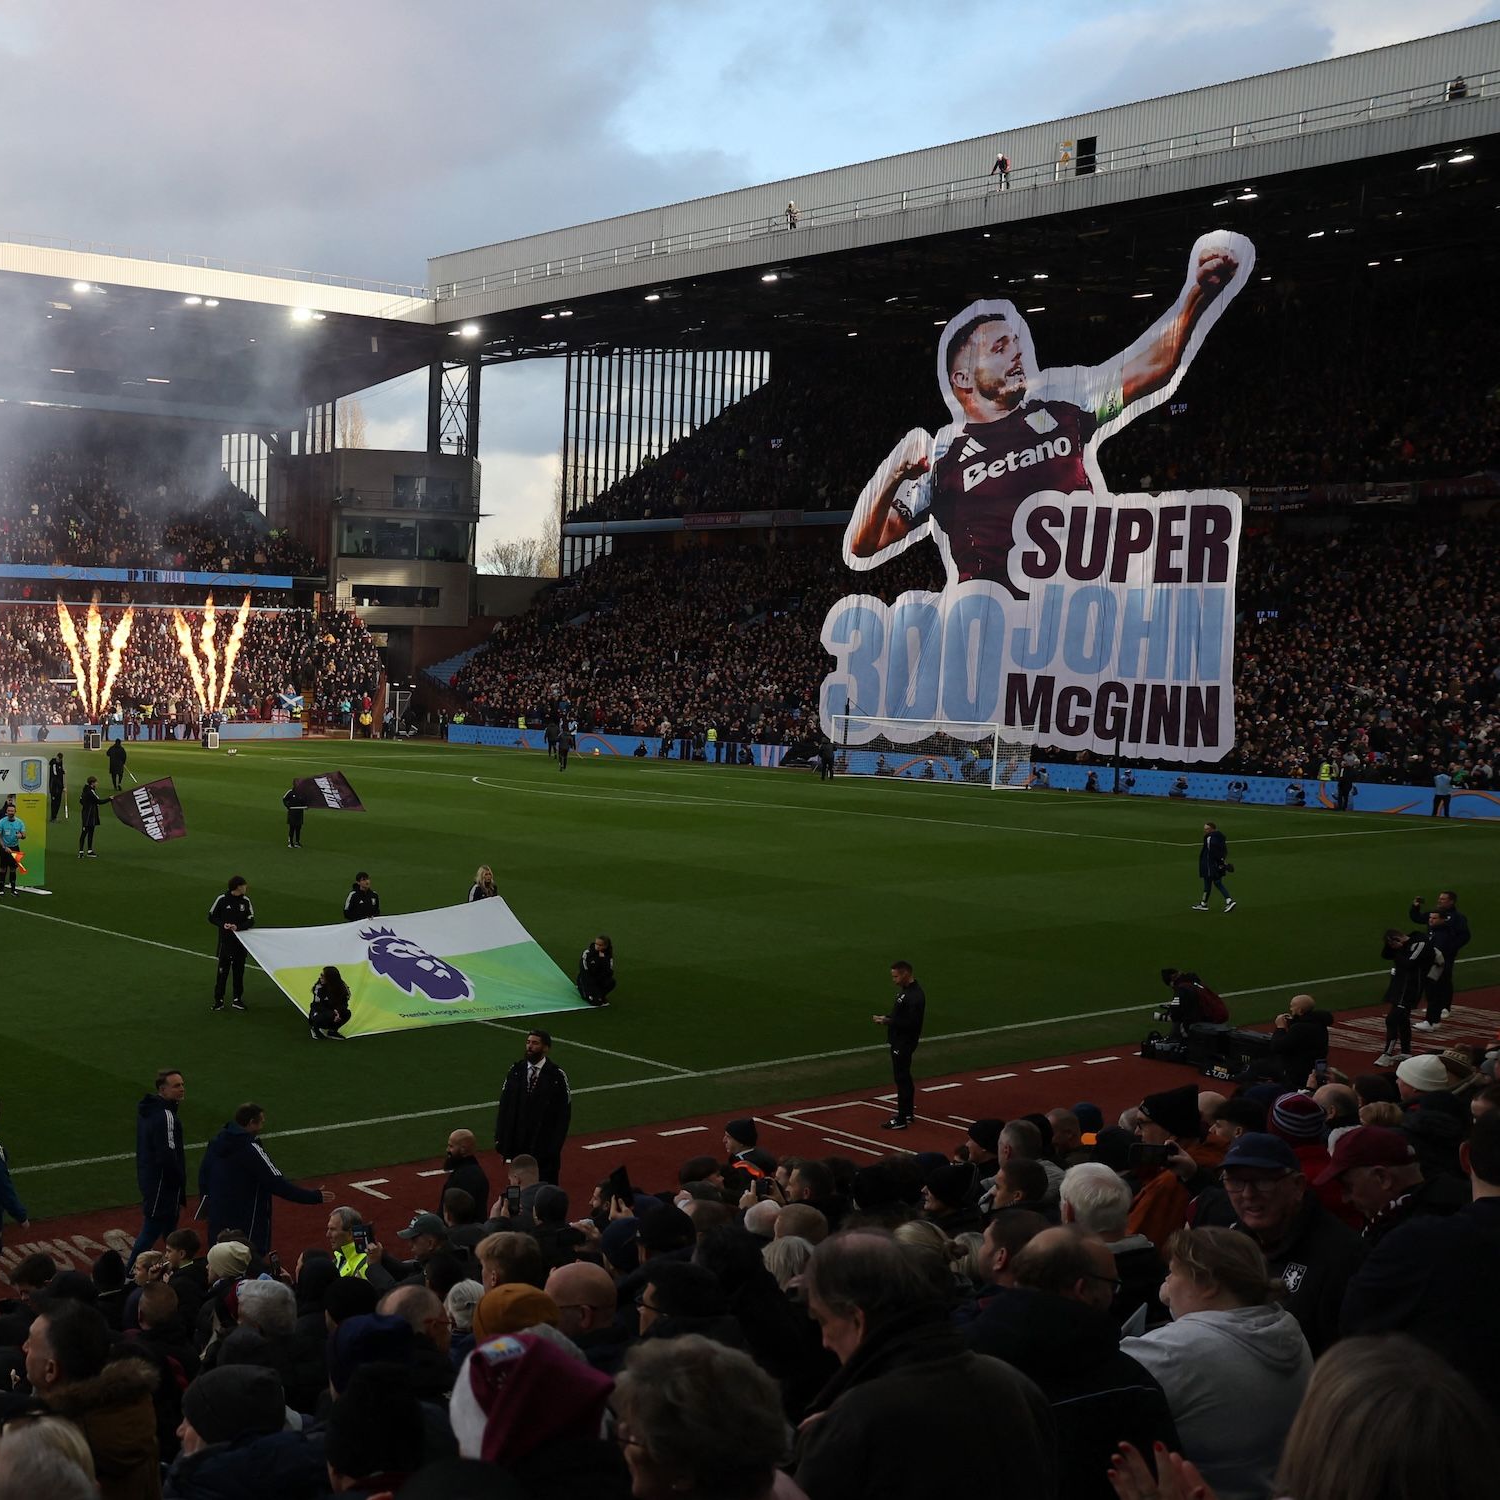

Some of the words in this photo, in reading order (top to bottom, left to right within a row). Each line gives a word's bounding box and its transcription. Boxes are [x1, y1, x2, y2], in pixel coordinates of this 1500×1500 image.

[962, 437, 1072, 493] Betano
[127, 571, 139, 581] UP
[142, 571, 158, 581] THE
[163, 572, 186, 583] VILLA
[1021, 504, 1232, 583] SUPER
[826, 594, 1006, 731] 300
[1010, 583, 1226, 681] JOHN
[132, 786, 154, 817] VILLA
